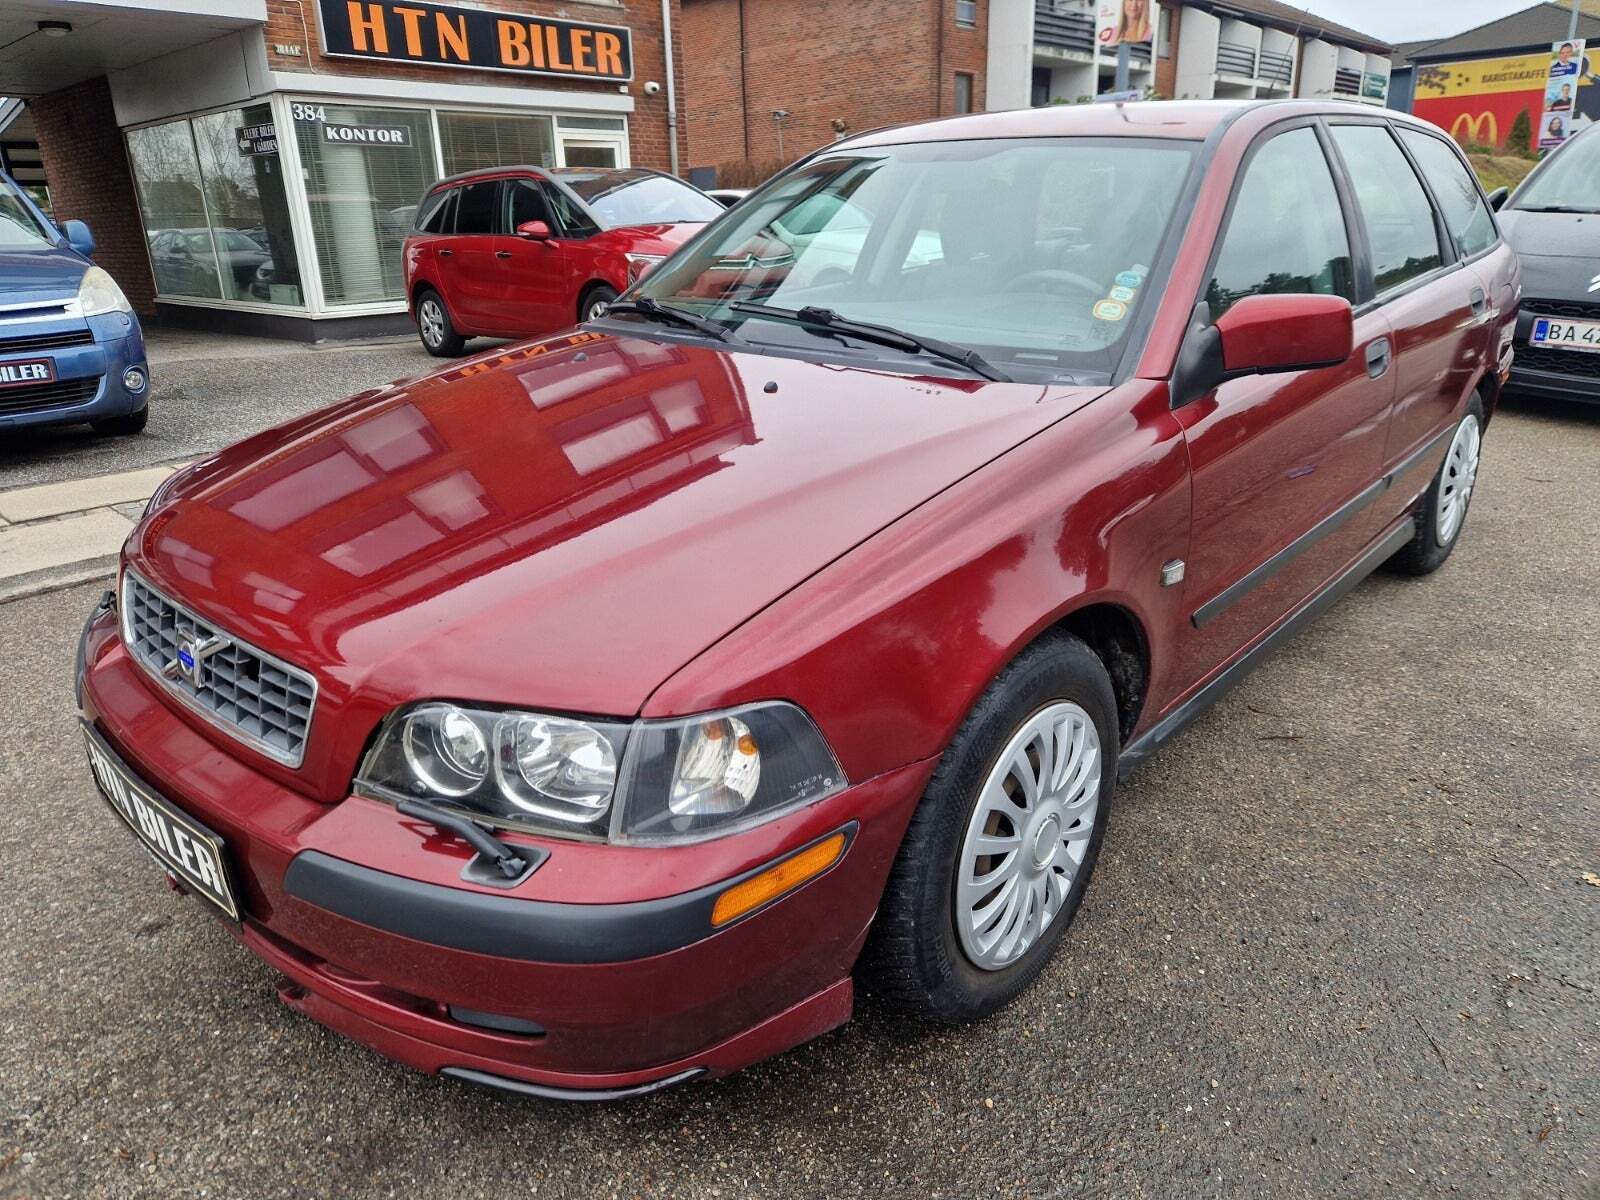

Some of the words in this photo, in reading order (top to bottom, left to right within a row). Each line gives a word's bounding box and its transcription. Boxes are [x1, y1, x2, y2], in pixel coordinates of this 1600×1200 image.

[346, 1, 470, 62] HTN
[496, 19, 624, 75] BILER
[293, 103, 327, 122] 384
[325, 126, 403, 143] KONTOR
[1549, 324, 1576, 341] BA
[0, 364, 48, 382] ILER
[129, 790, 224, 897] BILER
